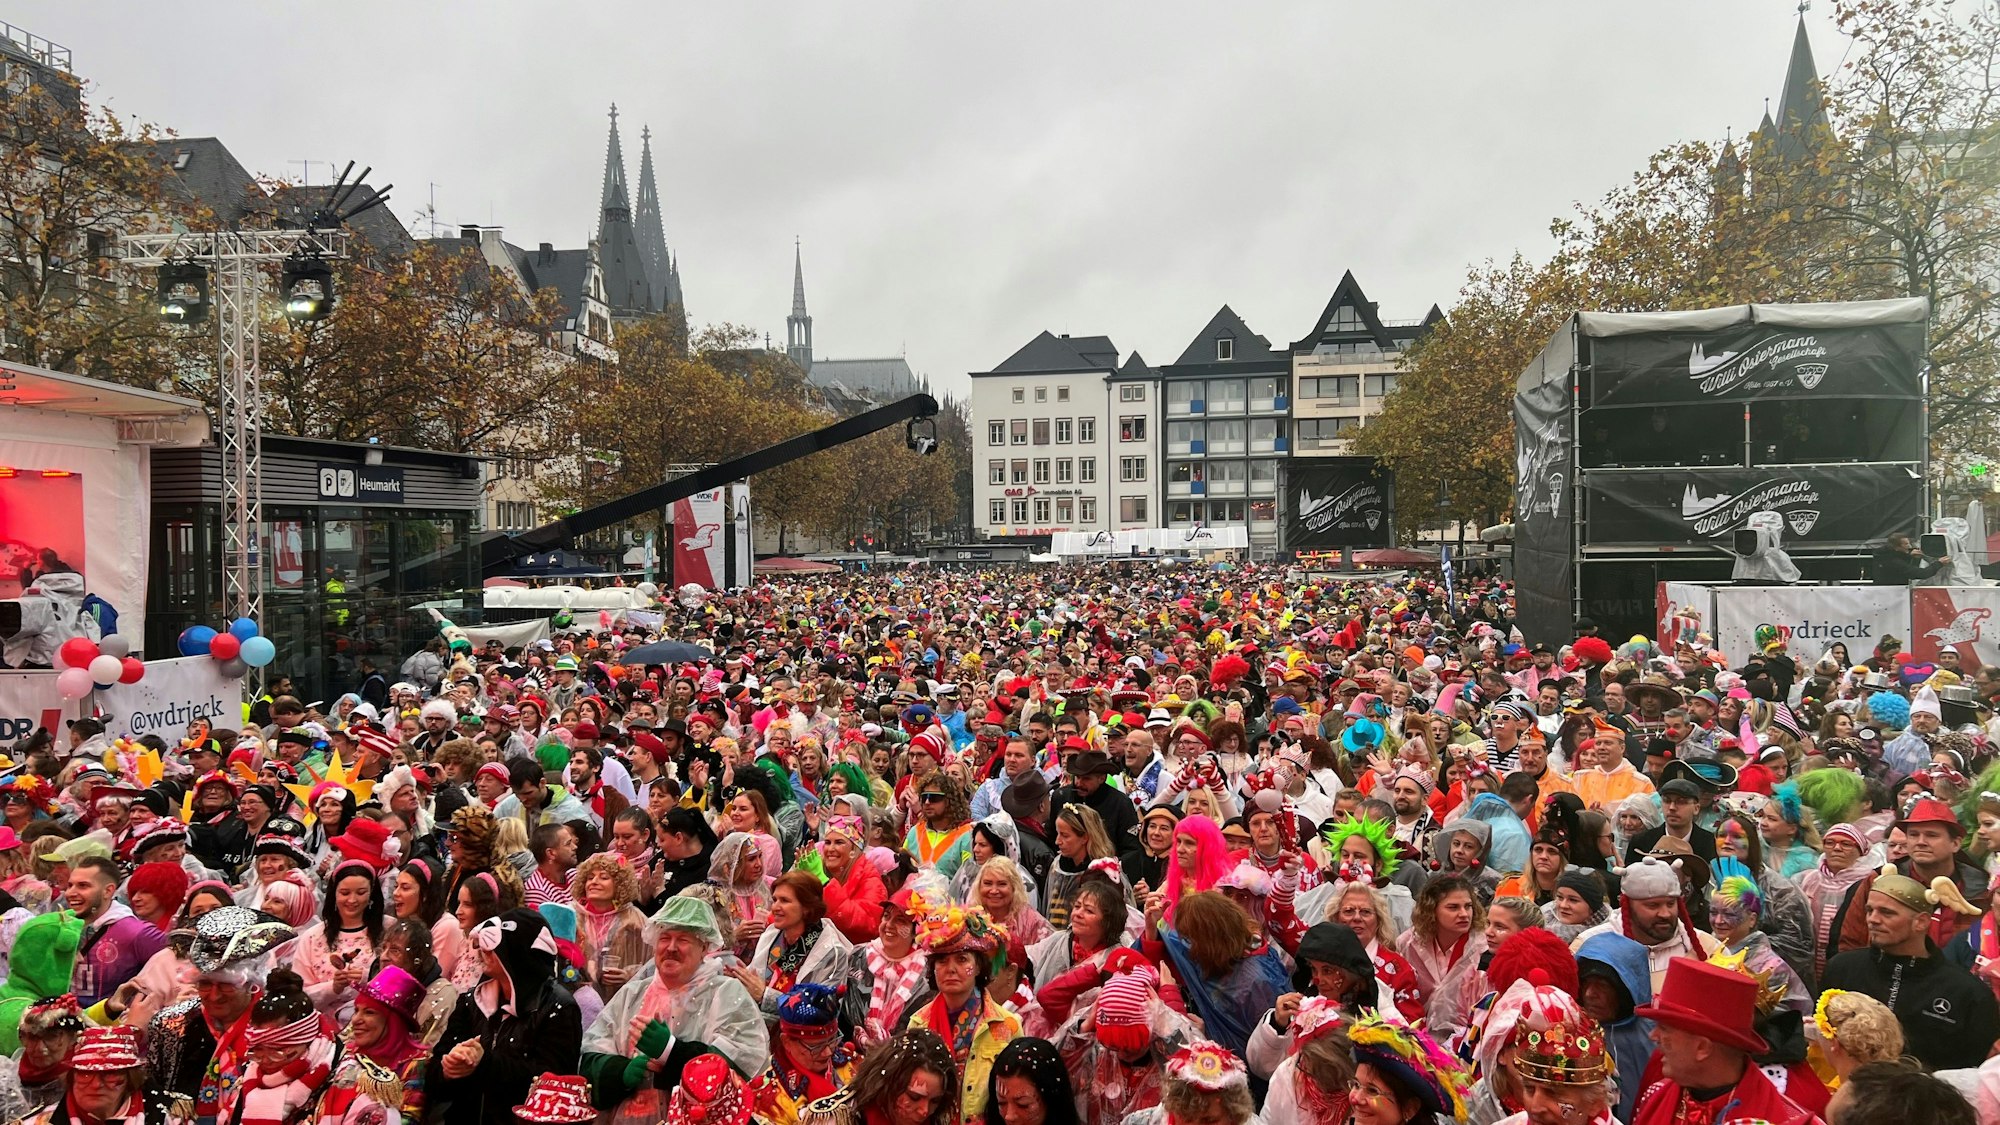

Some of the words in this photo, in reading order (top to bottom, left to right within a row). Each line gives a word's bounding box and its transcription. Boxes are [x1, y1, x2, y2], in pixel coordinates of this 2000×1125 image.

[1700, 366, 1736, 393] Willi
[1738, 335, 1817, 377] Ostermann
[1769, 346, 1827, 370] Gesellschaft
[360, 478, 400, 492] Heumarkt
[1005, 488, 1023, 497] GAG
[1694, 510, 1731, 534] Willi
[1732, 480, 1811, 520] Ostermann
[1306, 508, 1333, 531] Willi
[1184, 526, 1213, 542] Sion
[0, 718, 33, 740] DR
